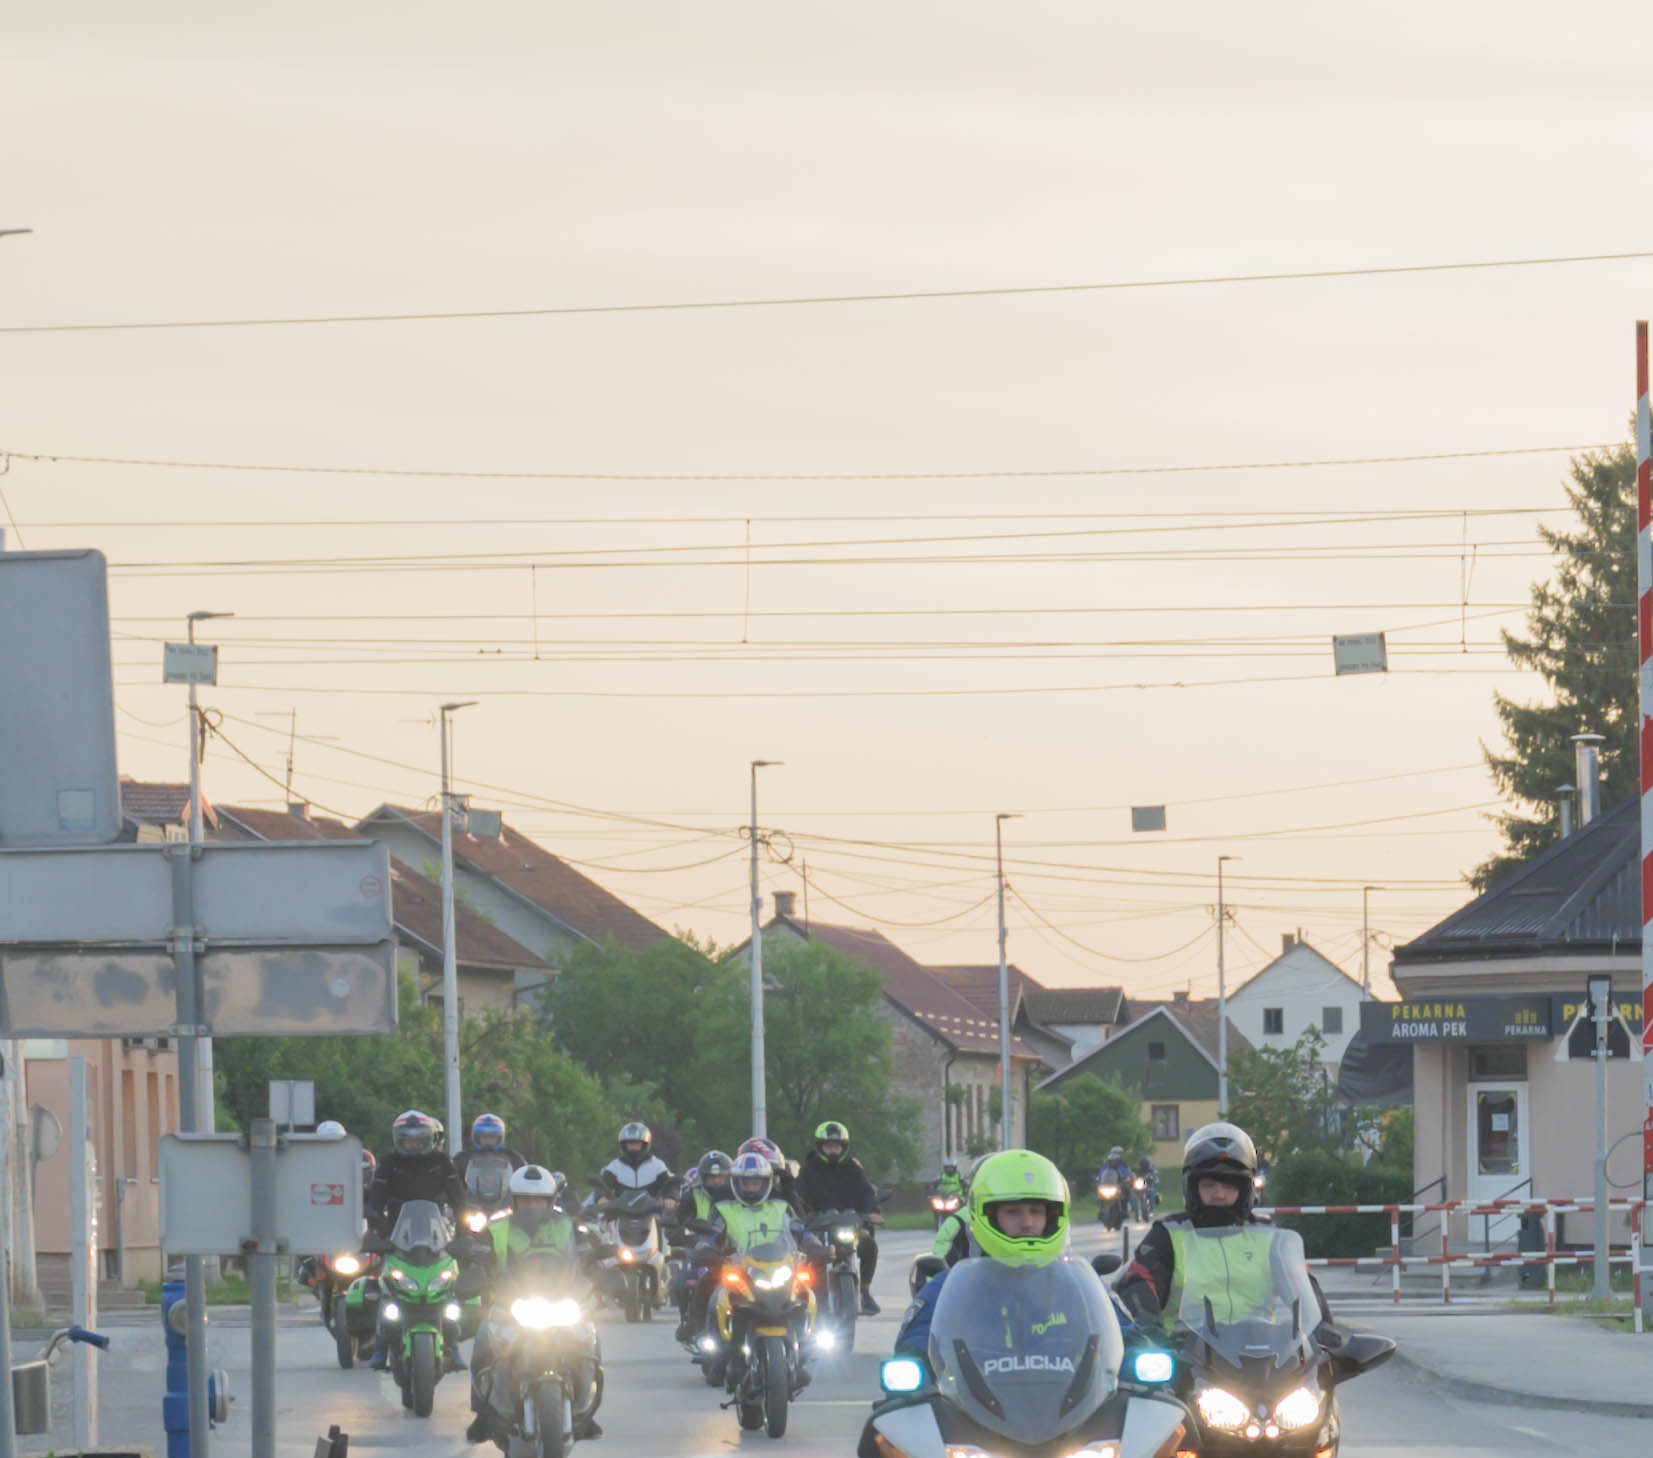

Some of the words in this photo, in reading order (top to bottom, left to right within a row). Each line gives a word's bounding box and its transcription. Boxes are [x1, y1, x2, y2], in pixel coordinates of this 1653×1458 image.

[1392, 1003, 1466, 1019] PEKARNA
[1392, 1022, 1438, 1037] AROMA
[1443, 1021, 1467, 1036] PEK
[1505, 1024, 1547, 1035] PEKARNA
[984, 1354, 1075, 1376] POLICIJA
